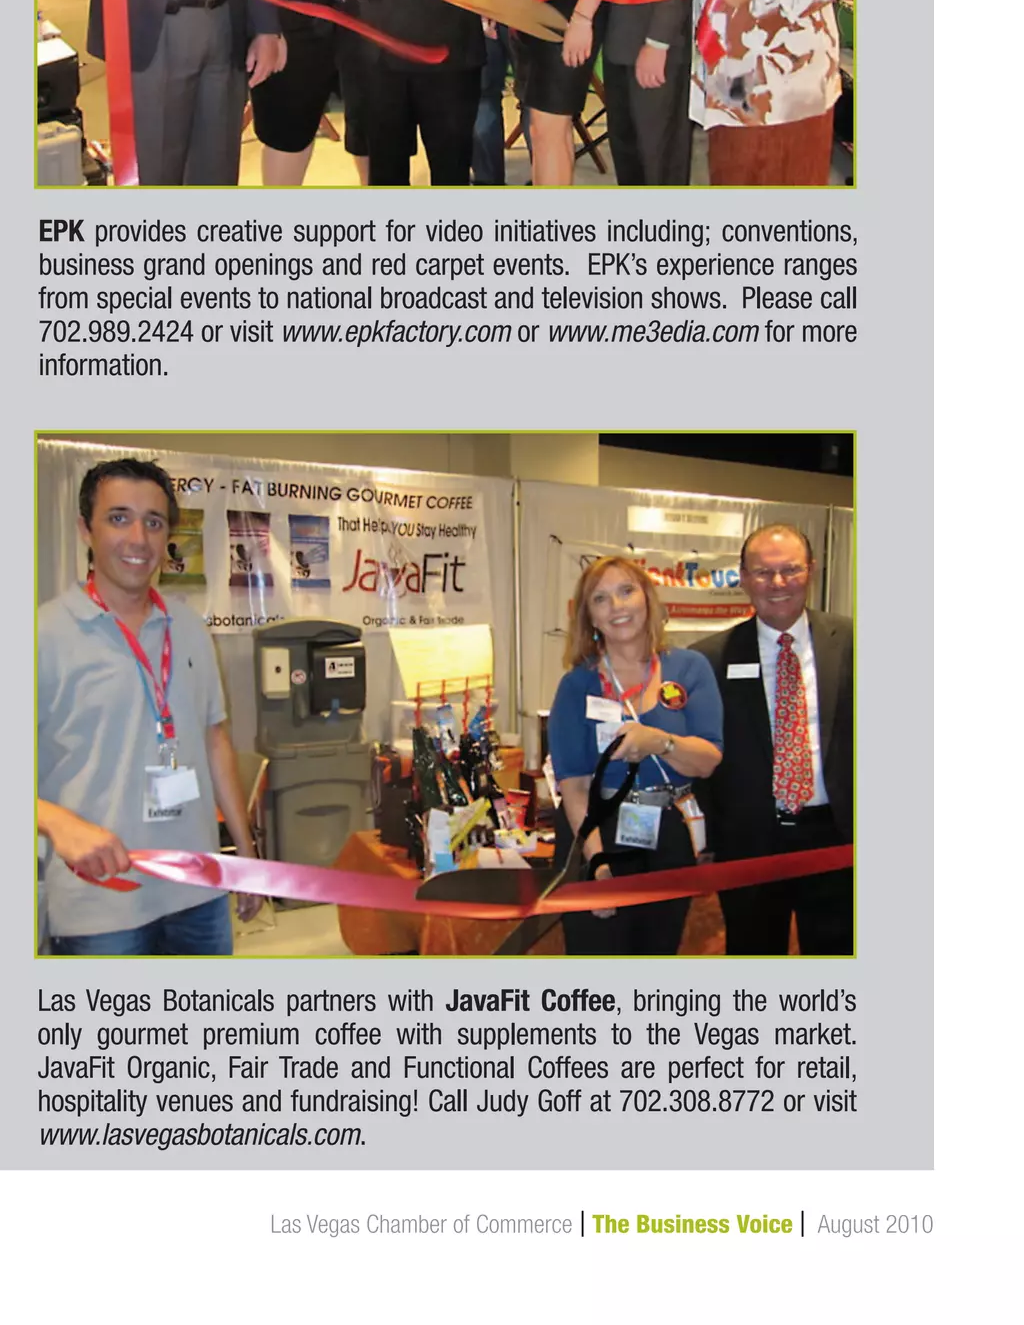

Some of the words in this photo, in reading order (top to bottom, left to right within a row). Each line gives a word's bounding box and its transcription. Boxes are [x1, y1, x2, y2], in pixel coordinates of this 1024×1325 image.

[39, 320, 194, 342] 702.989.2424
[202, 325, 223, 342] or
[230, 320, 273, 342] visit
[283, 320, 512, 347] www.epkfactory.com
[518, 325, 539, 342] or
[550, 320, 759, 342] www.me3edia.com
[765, 320, 795, 342] for
[803, 325, 857, 342] more
[231, 479, 266, 497] FAT
[267, 482, 343, 502] BURNING
[346, 486, 424, 509] GOURMET
[426, 495, 474, 510] COFFEE
[337, 516, 361, 532] That
[391, 521, 415, 536] YOU
[416, 522, 436, 539] Stay
[438, 523, 477, 540] Healthy
[342, 548, 467, 594] JavaFit
[41, 1123, 365, 1151] www.lasvegasbotanicals.com.
[272, 1215, 301, 1233] Las
[307, 1215, 359, 1237] Vegas
[367, 1214, 447, 1233] Chamber
[454, 1215, 470, 1233] of
[477, 1214, 572, 1233] Commerce
[592, 1214, 630, 1234] The
[637, 1214, 730, 1234] Business
[736, 1214, 793, 1234] Voice
[818, 1215, 879, 1237] August
[887, 1215, 933, 1233] 2010
